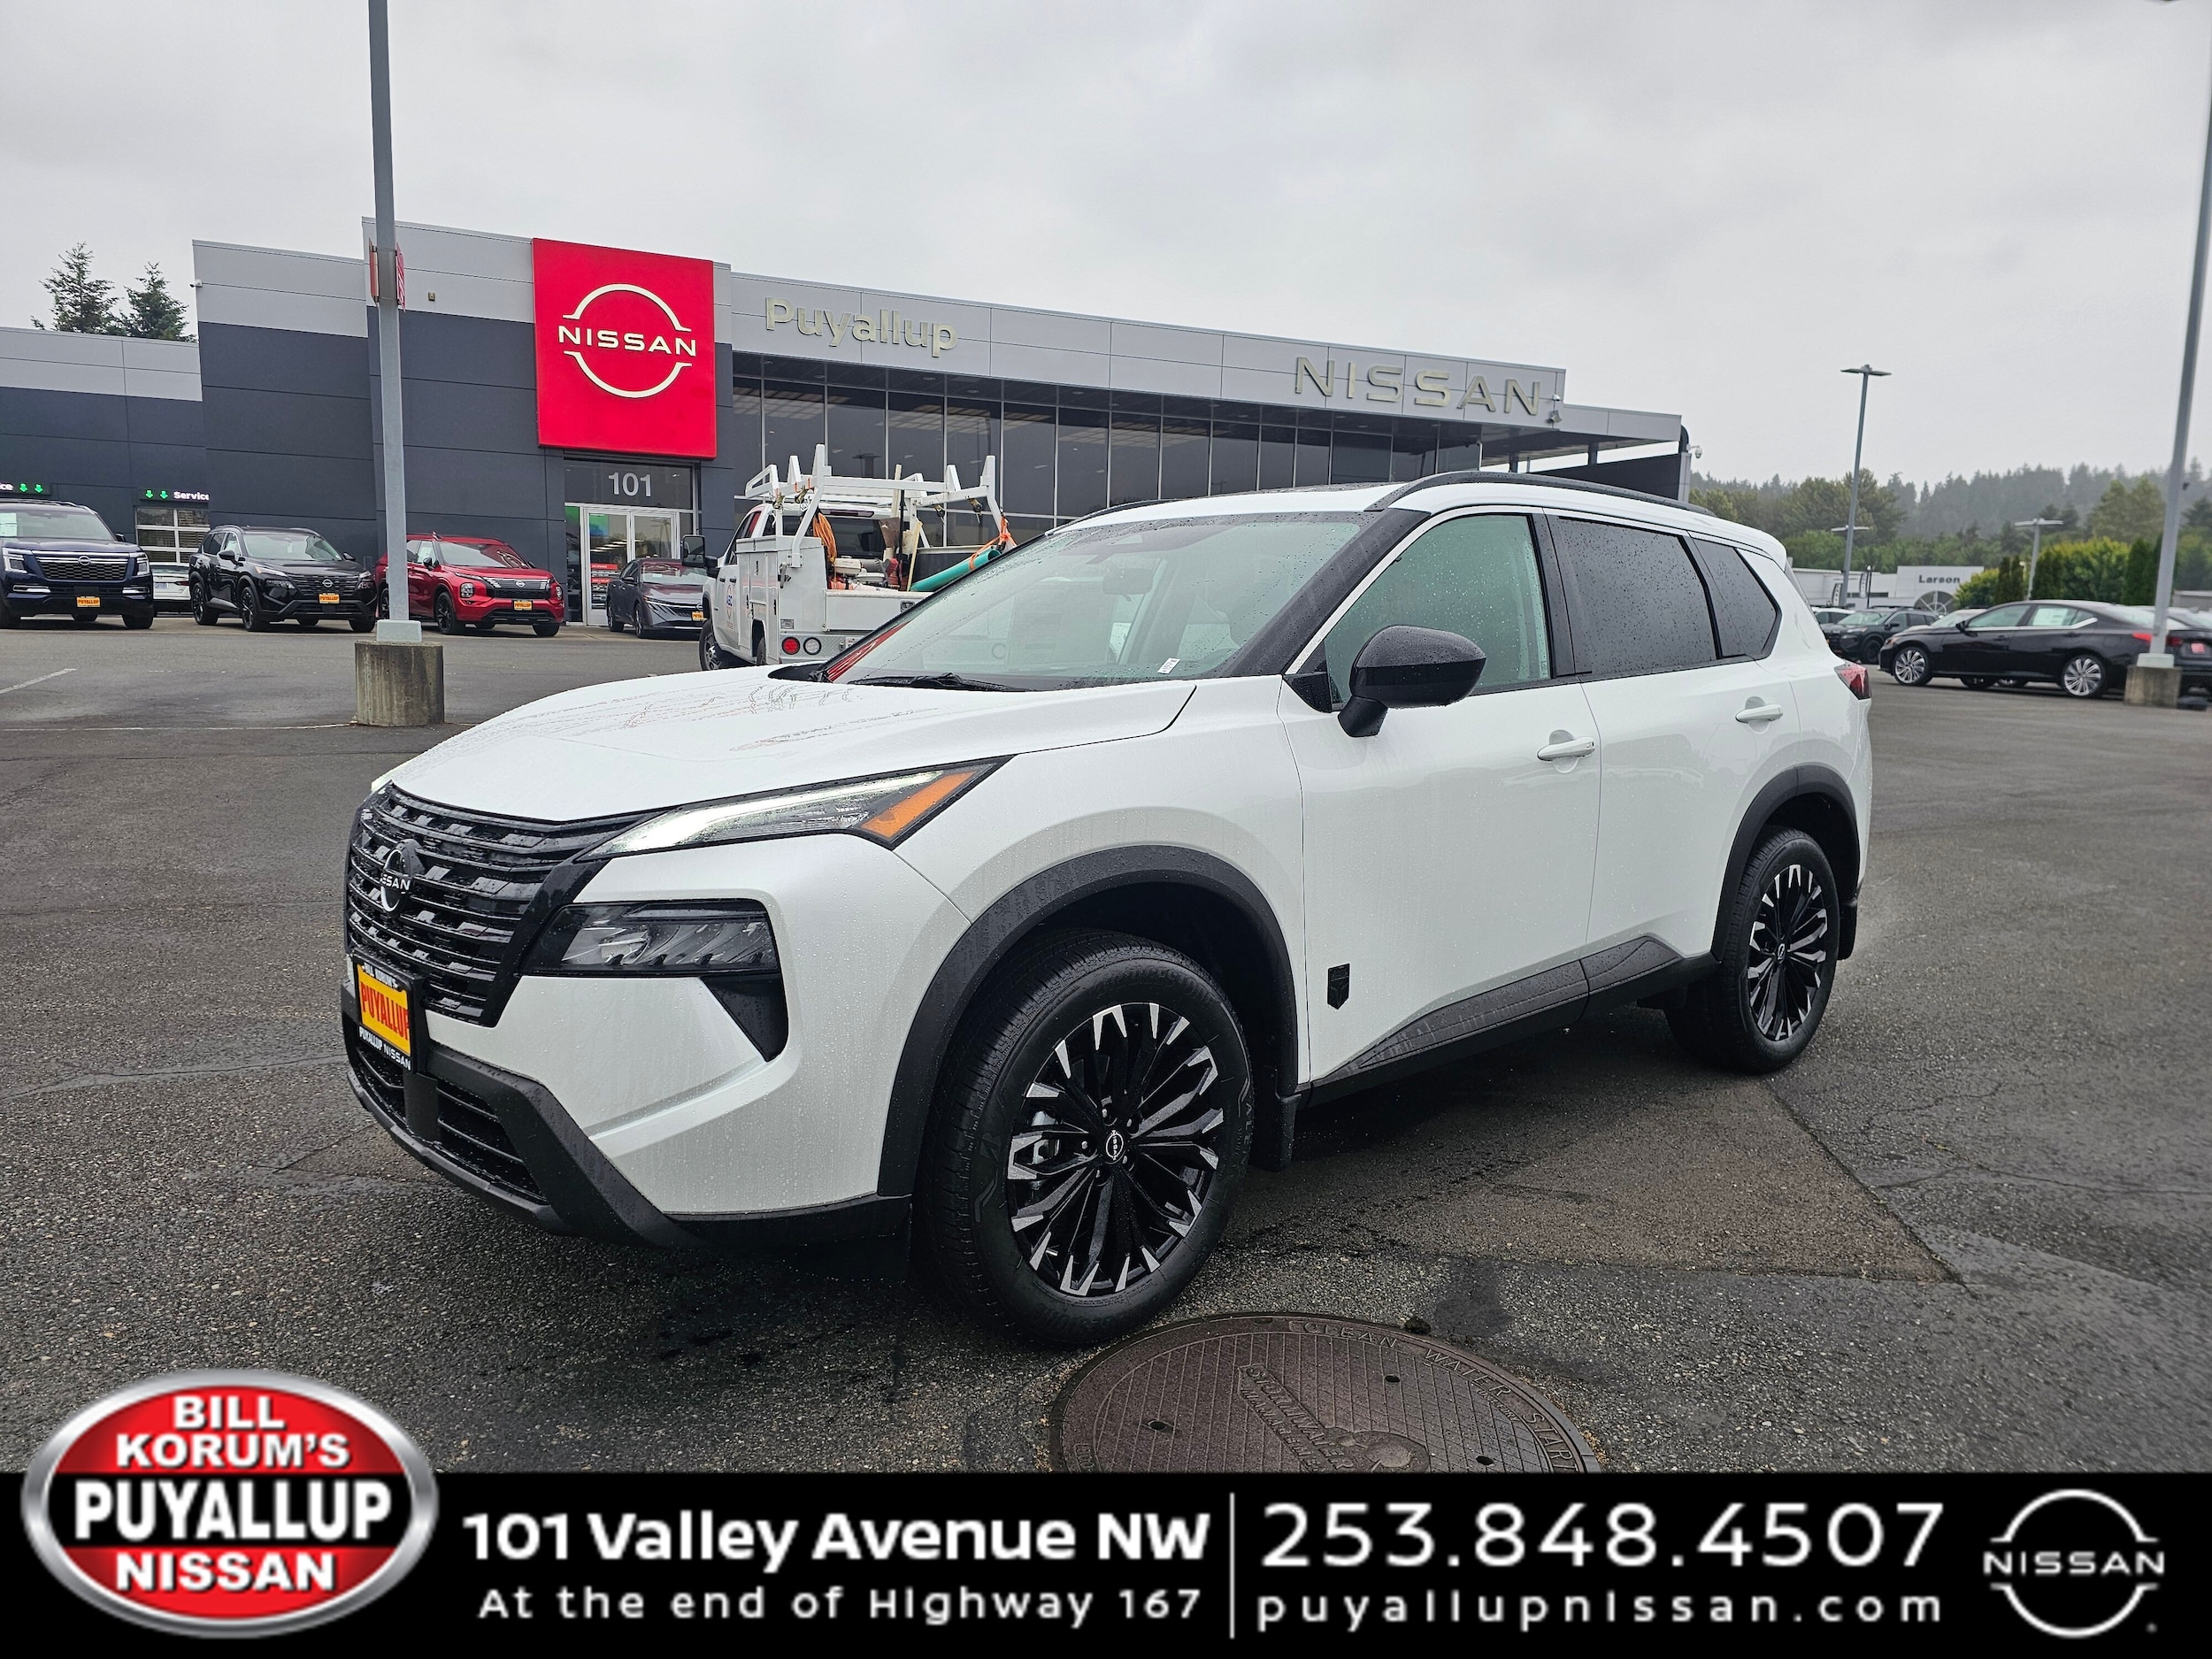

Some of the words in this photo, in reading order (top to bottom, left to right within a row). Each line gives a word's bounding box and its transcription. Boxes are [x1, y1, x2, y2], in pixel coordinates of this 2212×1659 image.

[557, 325, 697, 357] NISSAN
[764, 296, 958, 358] Puyallup
[1294, 356, 1541, 417] NISSAN
[608, 472, 652, 498] 101
[1918, 574, 1961, 584] Larson
[380, 873, 411, 891] SSAN
[359, 980, 411, 1041] PUYALLUP
[383, 1043, 411, 1071] NISSAN
[1304, 1321, 1397, 1348] CLEAN
[1425, 1348, 1511, 1397] WATER
